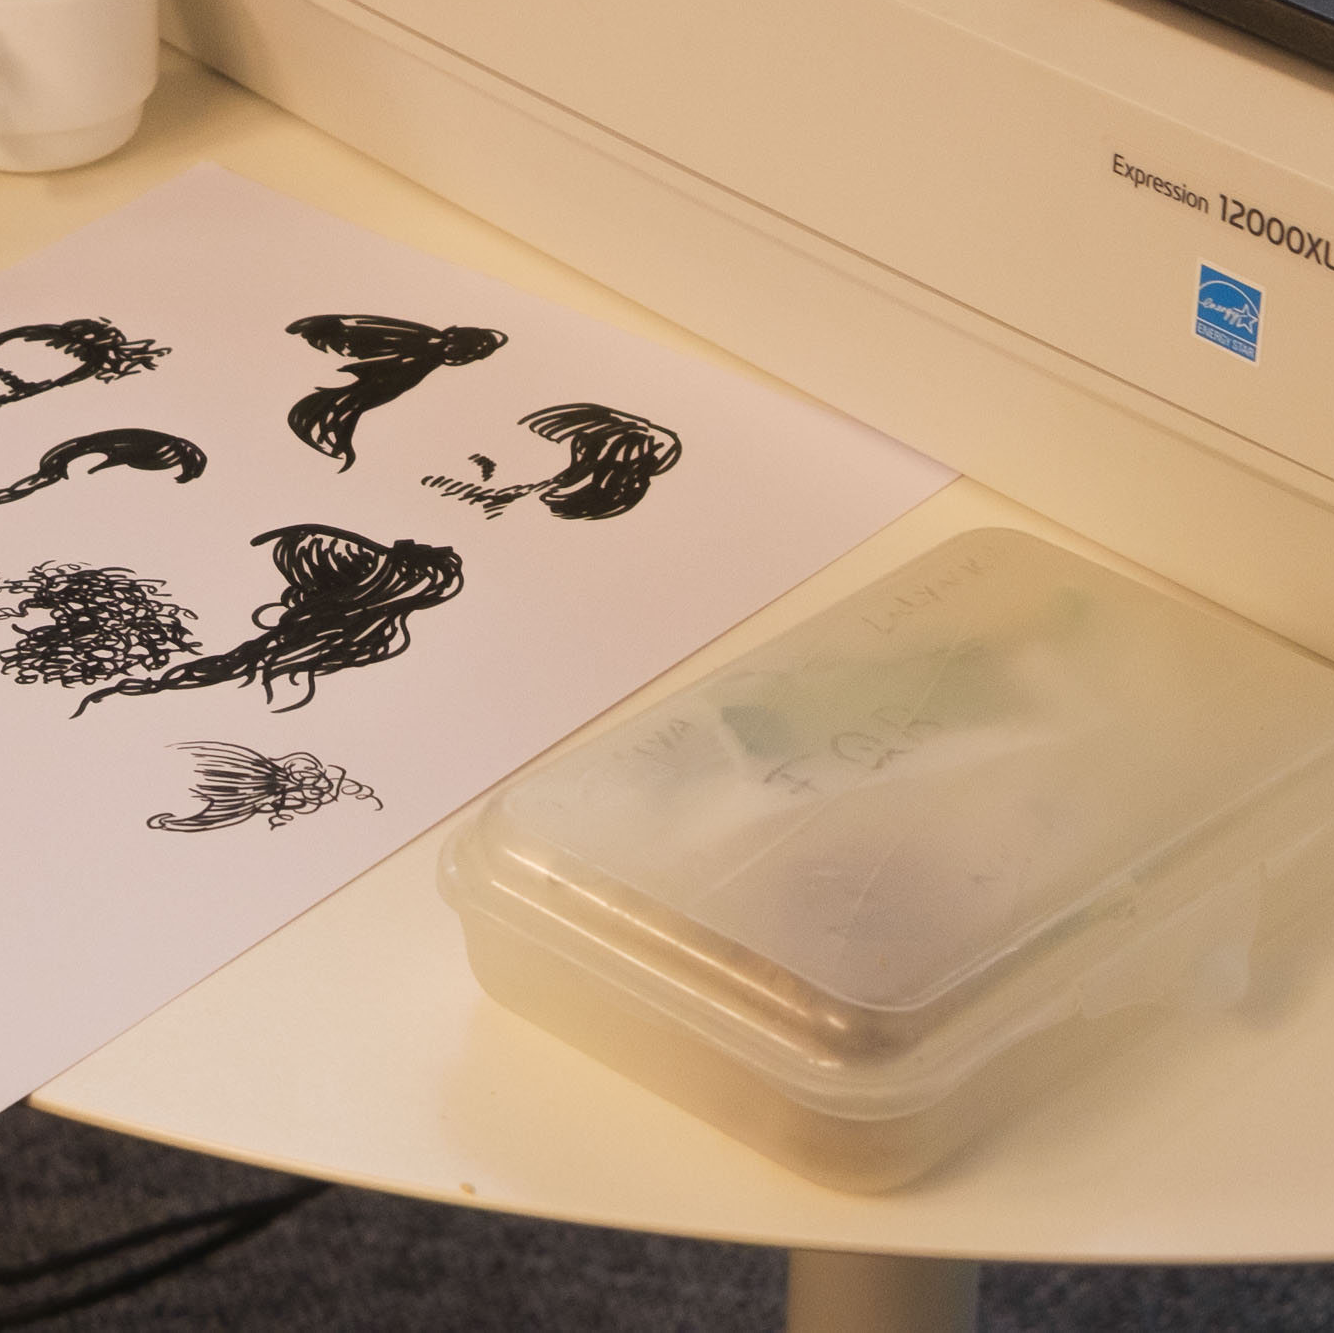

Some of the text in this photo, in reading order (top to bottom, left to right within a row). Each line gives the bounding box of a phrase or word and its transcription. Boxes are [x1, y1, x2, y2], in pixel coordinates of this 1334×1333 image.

[1111, 152, 1209, 214] Expression
[1197, 322, 1256, 359] ENERGY STAR
